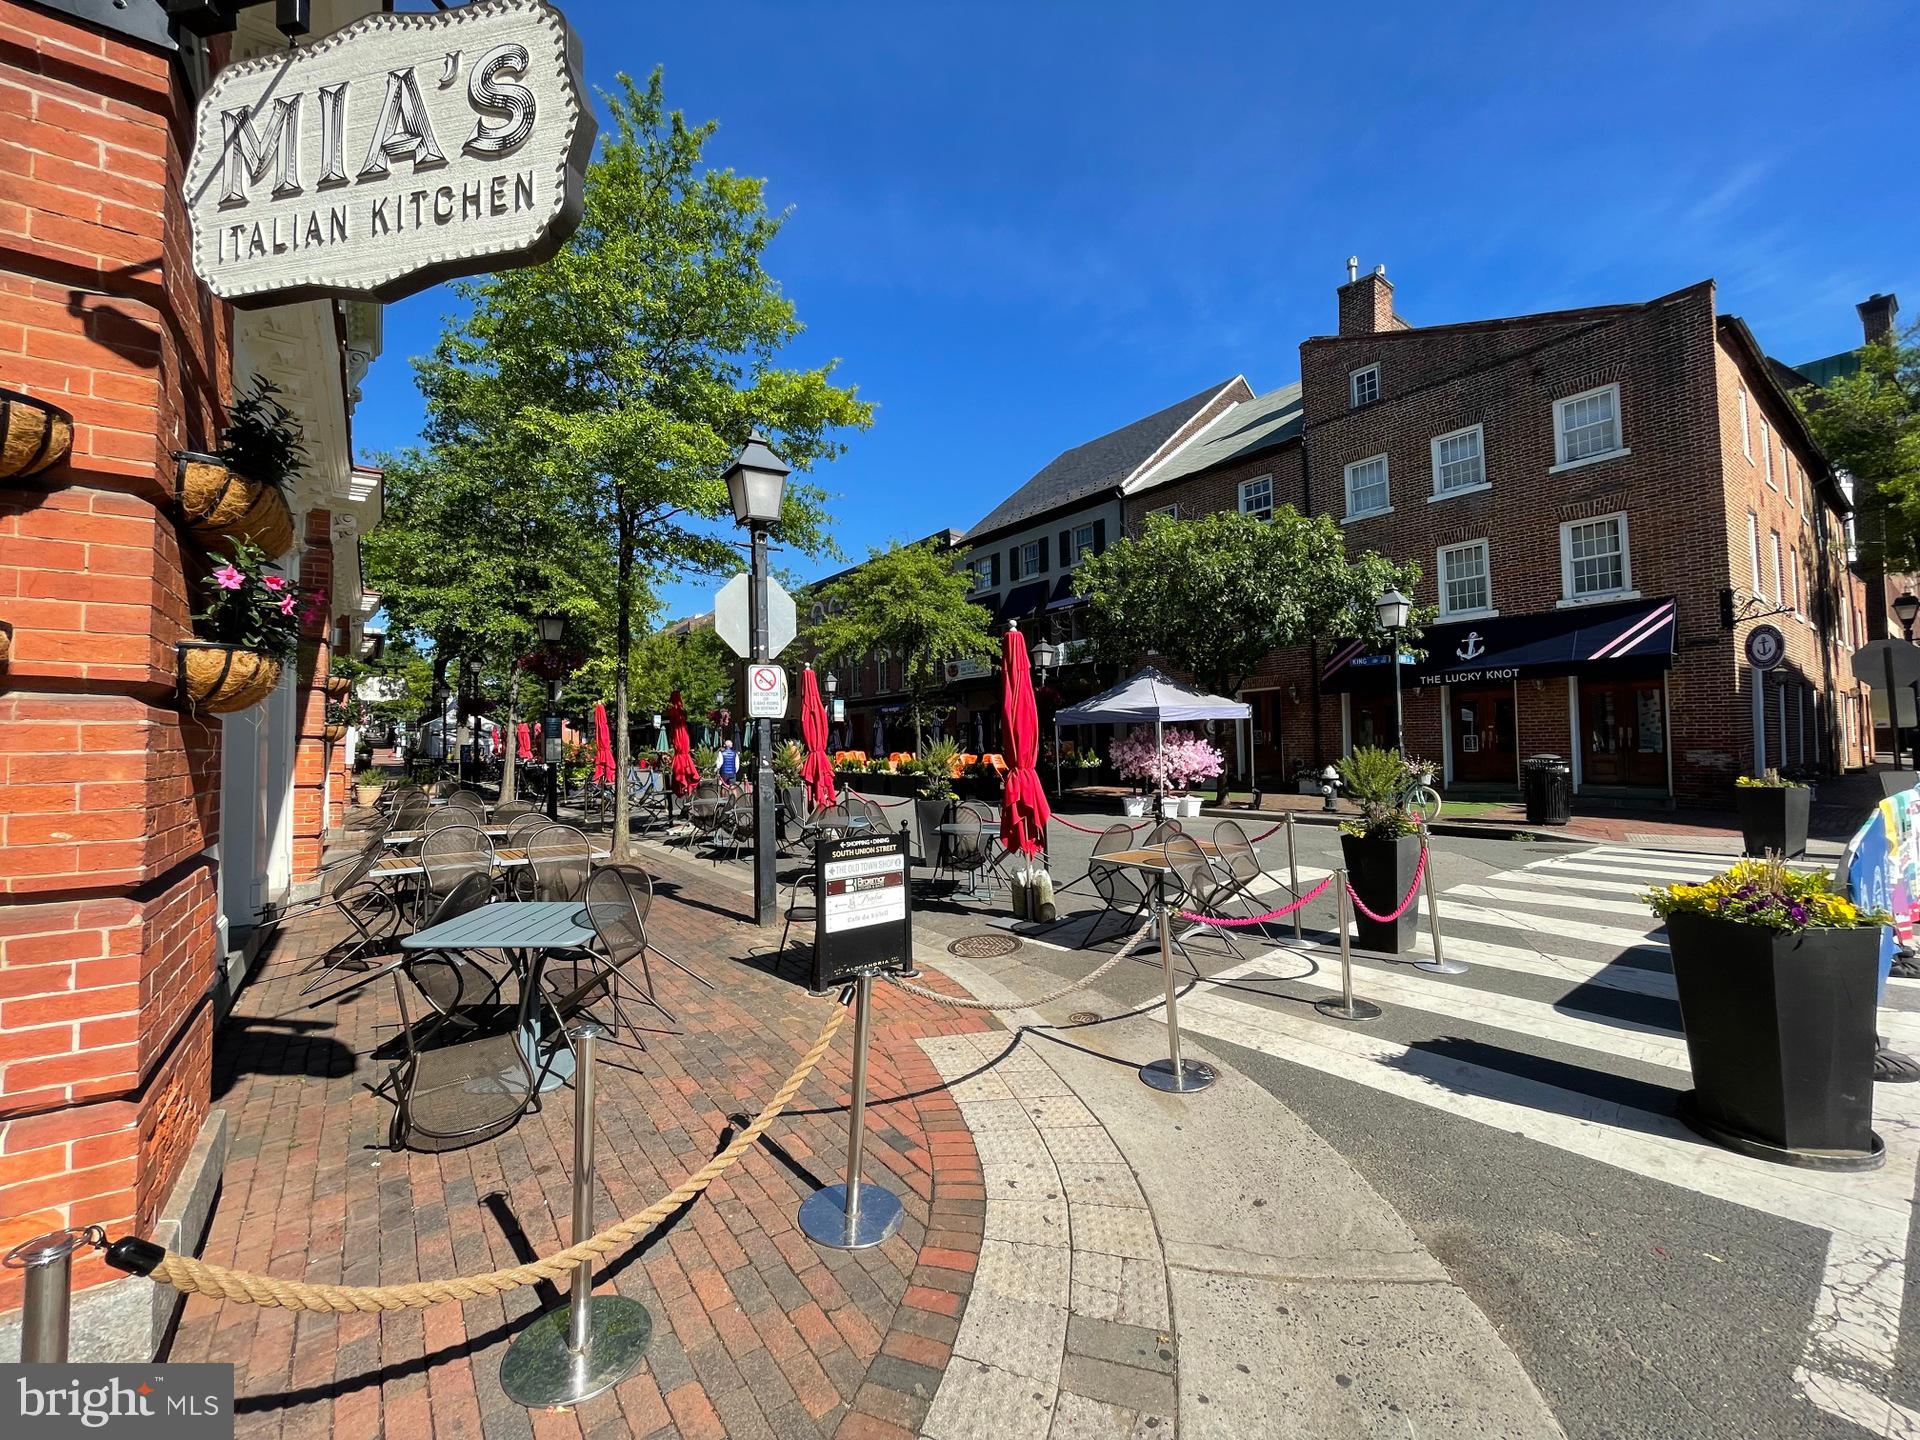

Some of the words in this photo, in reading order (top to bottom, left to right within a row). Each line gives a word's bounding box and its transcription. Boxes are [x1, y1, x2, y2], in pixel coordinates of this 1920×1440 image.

[219, 43, 536, 209] MIA'S
[218, 204, 348, 264] ITALIAN
[371, 170, 535, 238] KITCHEN
[1420, 674, 1441, 685] THE
[1445, 671, 1482, 684] LUCKY
[1486, 668, 1520, 680] KNOT
[846, 839, 870, 848] SHOPPING
[873, 837, 890, 845] DINING
[832, 849, 855, 858] SOUTH
[855, 847, 875, 856] UNION
[876, 844, 897, 854] STREET
[836, 865, 848, 875] THE
[848, 864, 860, 873] OLD
[860, 861, 878, 872] TOWN
[878, 860, 894, 870] SHOP
